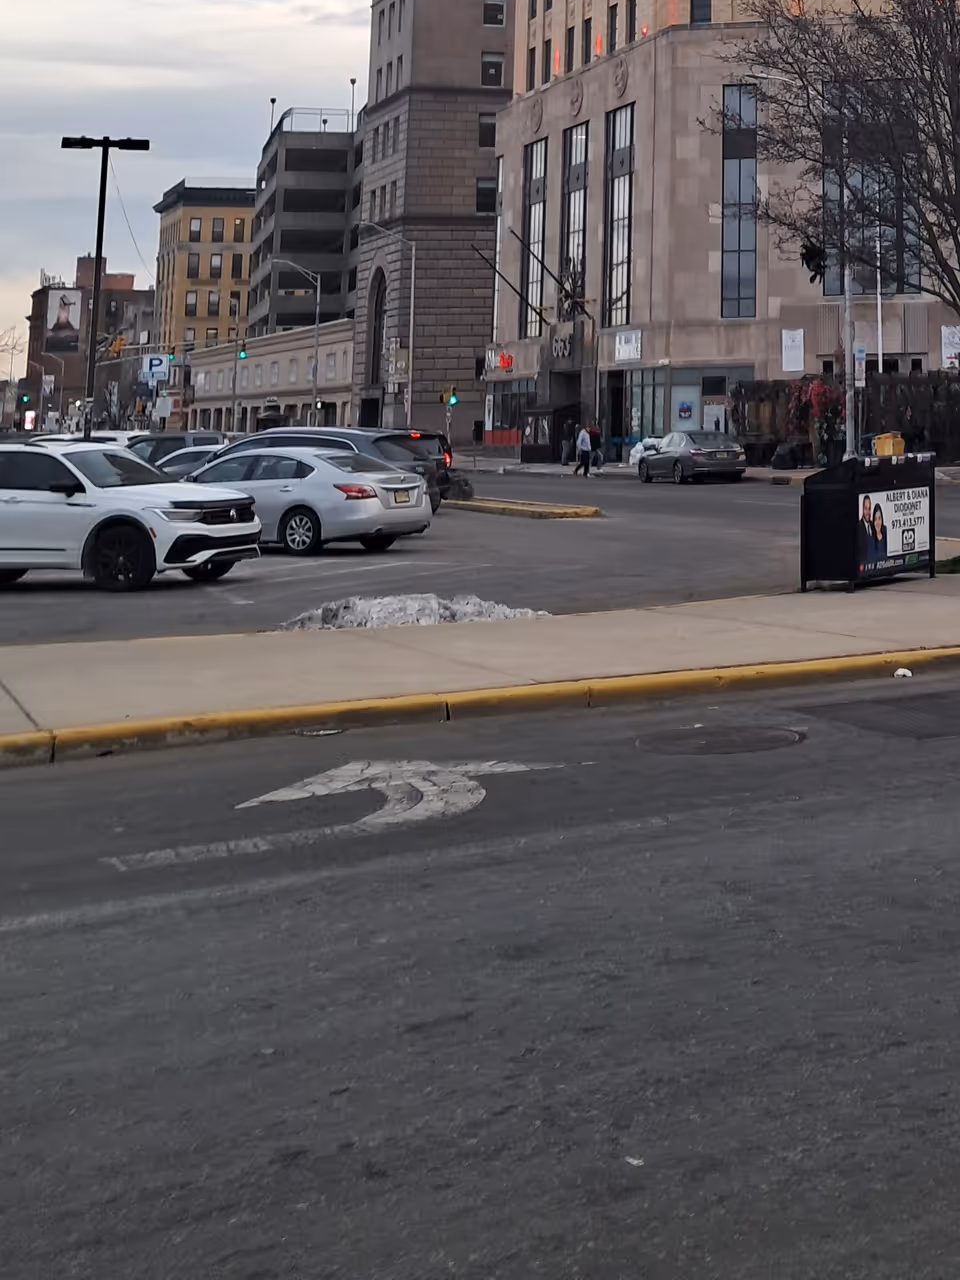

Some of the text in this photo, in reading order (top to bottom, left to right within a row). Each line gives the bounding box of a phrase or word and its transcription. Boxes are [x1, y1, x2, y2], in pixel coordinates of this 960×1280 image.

[148, 357, 163, 371] P
[886, 488, 928, 503] ALBERT & DIANA
